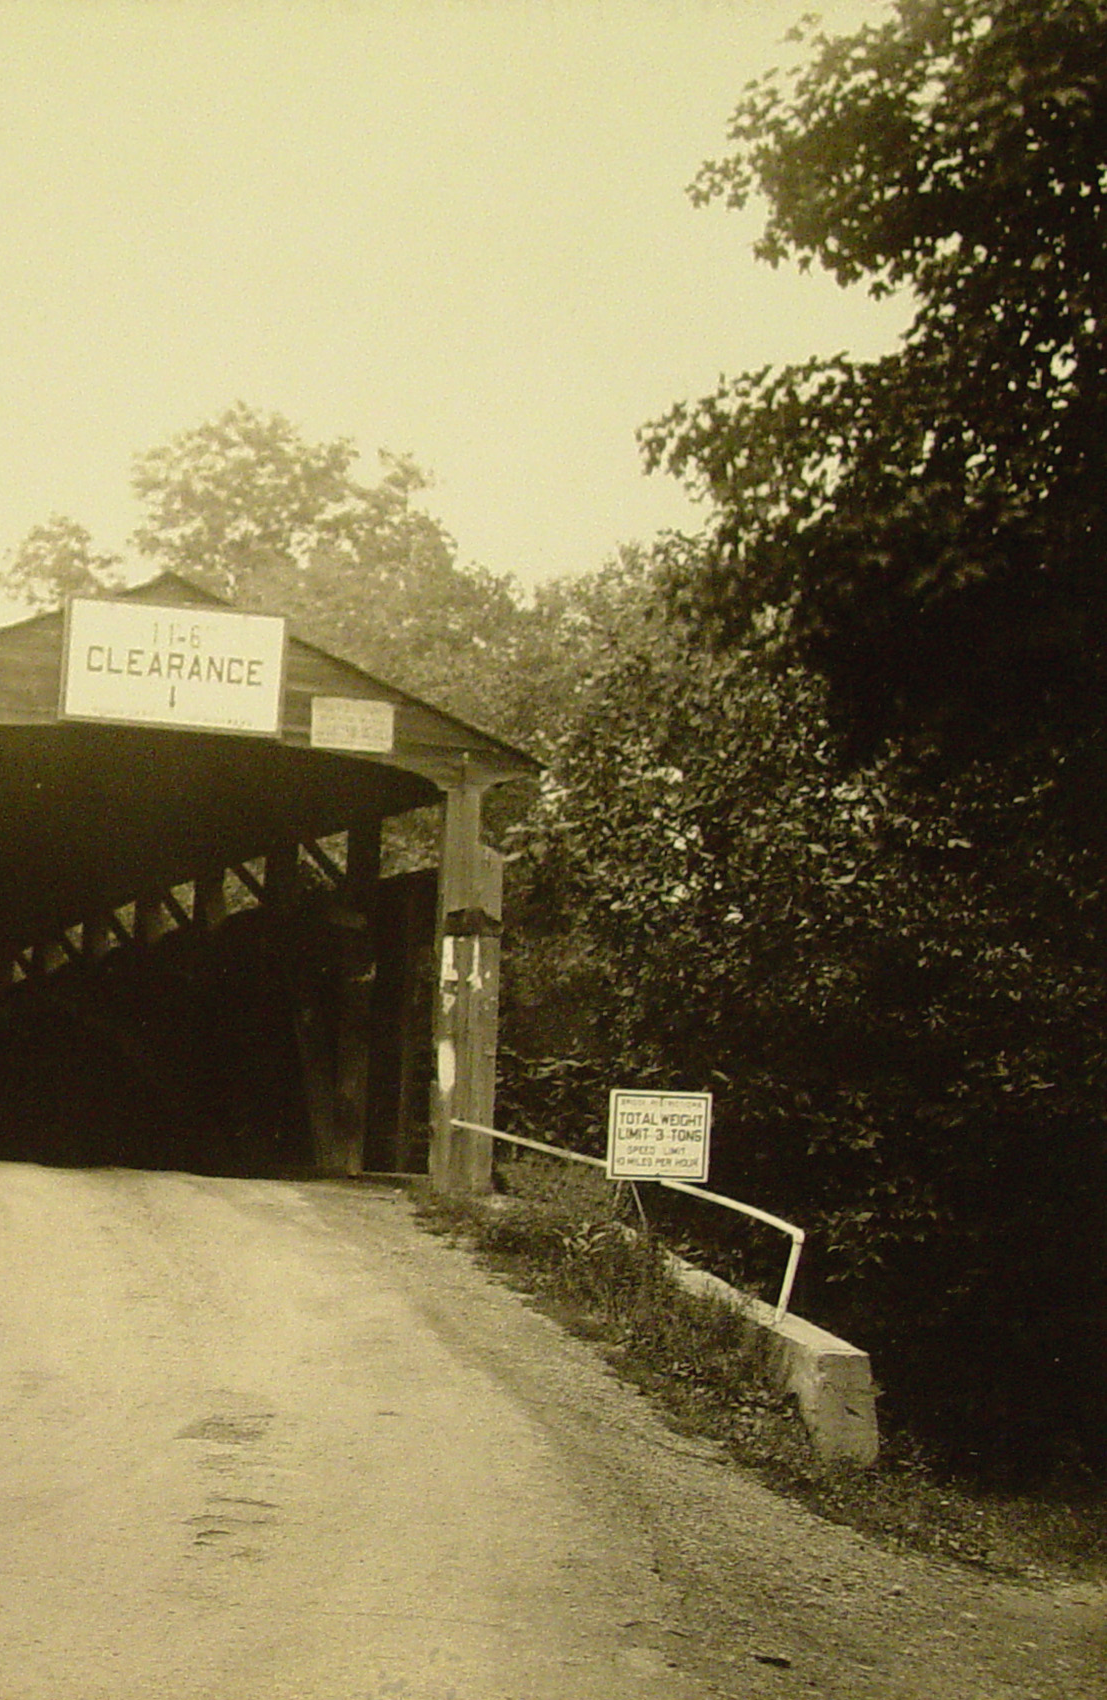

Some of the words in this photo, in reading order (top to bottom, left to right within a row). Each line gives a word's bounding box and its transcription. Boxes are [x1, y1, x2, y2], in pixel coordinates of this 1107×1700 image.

[86, 645, 264, 687] CLEARANCE
[619, 1111, 659, 1126] TOTAL
[661, 1113, 703, 1127] WEIGHT
[618, 1127, 649, 1140] LIMIT
[655, 1128, 665, 1141] 3
[671, 1128, 702, 1142] TONS
[627, 1145, 655, 1155] SPEED
[663, 1147, 686, 1156] LIMIT
